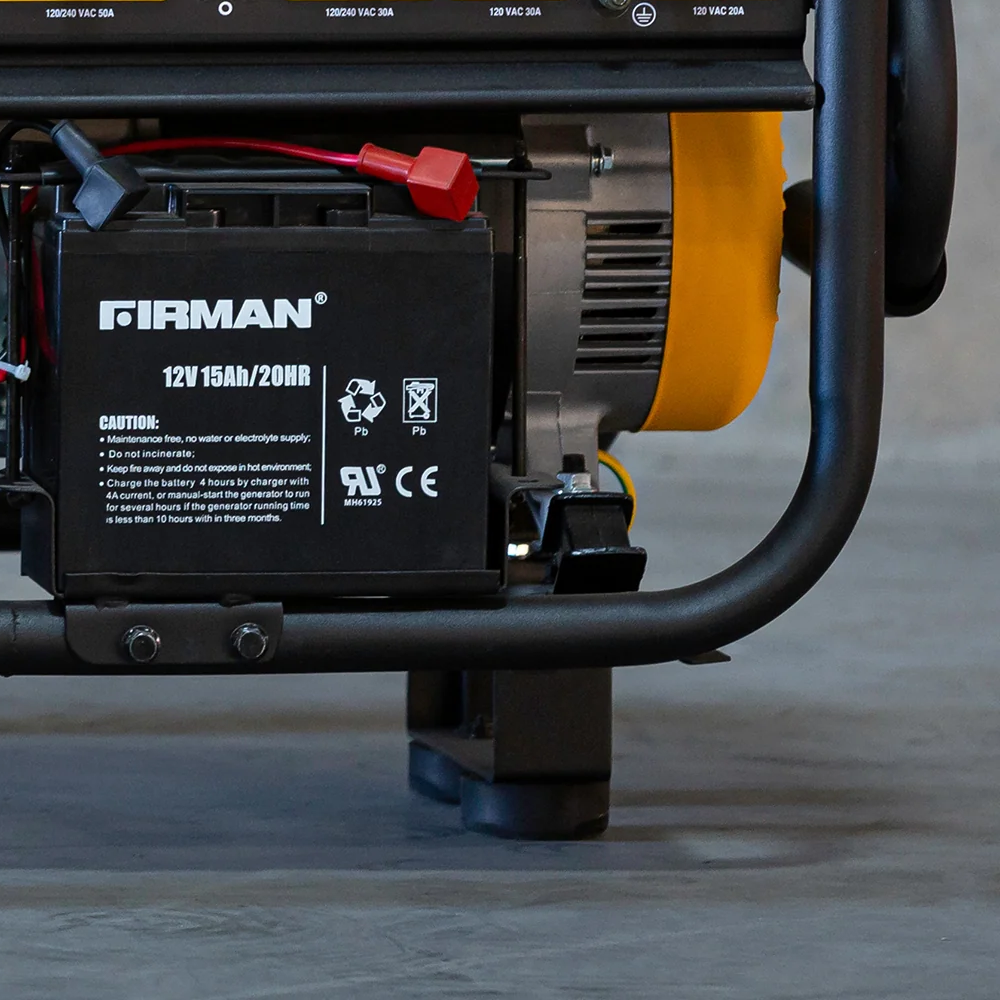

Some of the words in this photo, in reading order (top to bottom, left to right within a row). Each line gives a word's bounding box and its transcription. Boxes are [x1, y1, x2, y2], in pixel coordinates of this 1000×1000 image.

[45, 10, 76, 18] 120/240
[78, 9, 96, 18] VAC
[98, 9, 114, 18] 50A
[325, 8, 356, 17] 120/240
[358, 8, 376, 17] VAC
[377, 8, 393, 17] 30A
[489, 7, 504, 16] 120
[505, 7, 524, 16] VAC
[525, 7, 541, 16] 30A
[693, 6, 707, 15] 120
[709, 6, 727, 15] VAC
[728, 6, 744, 15] 20A
[163, 366, 198, 387] 12V
[201, 365, 310, 387] 15Ah/20HR
[99, 415, 159, 430] CAUTION:
[354, 427, 368, 436] Pb
[412, 426, 426, 435] Pb
[107, 435, 162, 444] Maintenance
[165, 435, 183, 444] free,
[235, 434, 278, 444] electrolyte
[281, 434, 311, 444] supply;
[109, 450, 122, 458] Do
[125, 450, 140, 458] not
[143, 450, 195, 459] incinerate;
[107, 465, 128, 475] Keep
[130, 465, 142, 473] fire
[144, 466, 164, 474] away
[209, 466, 237, 474] expose
[261, 463, 312, 472] environment;
[107, 480, 141, 489] Charge
[144, 479, 159, 487] the
[162, 479, 195, 489] battery
[238, 478, 248, 488] by
[251, 478, 287, 488] charger
[290, 478, 309, 486] with
[396, 466, 438, 497] CE
[168, 491, 223, 499] manual-start
[241, 492, 282, 500] generator
[156, 503, 181, 511] hours
[184, 503, 190, 511] if
[192, 503, 205, 511] the
[208, 503, 252, 513] generator
[254, 502, 288, 511] running
[291, 502, 309, 510] time
[116, 516, 133, 524] less
[169, 515, 193, 523] hours
[195, 515, 212, 523] with
[224, 514, 246, 522] three
[248, 514, 282, 522] months.
